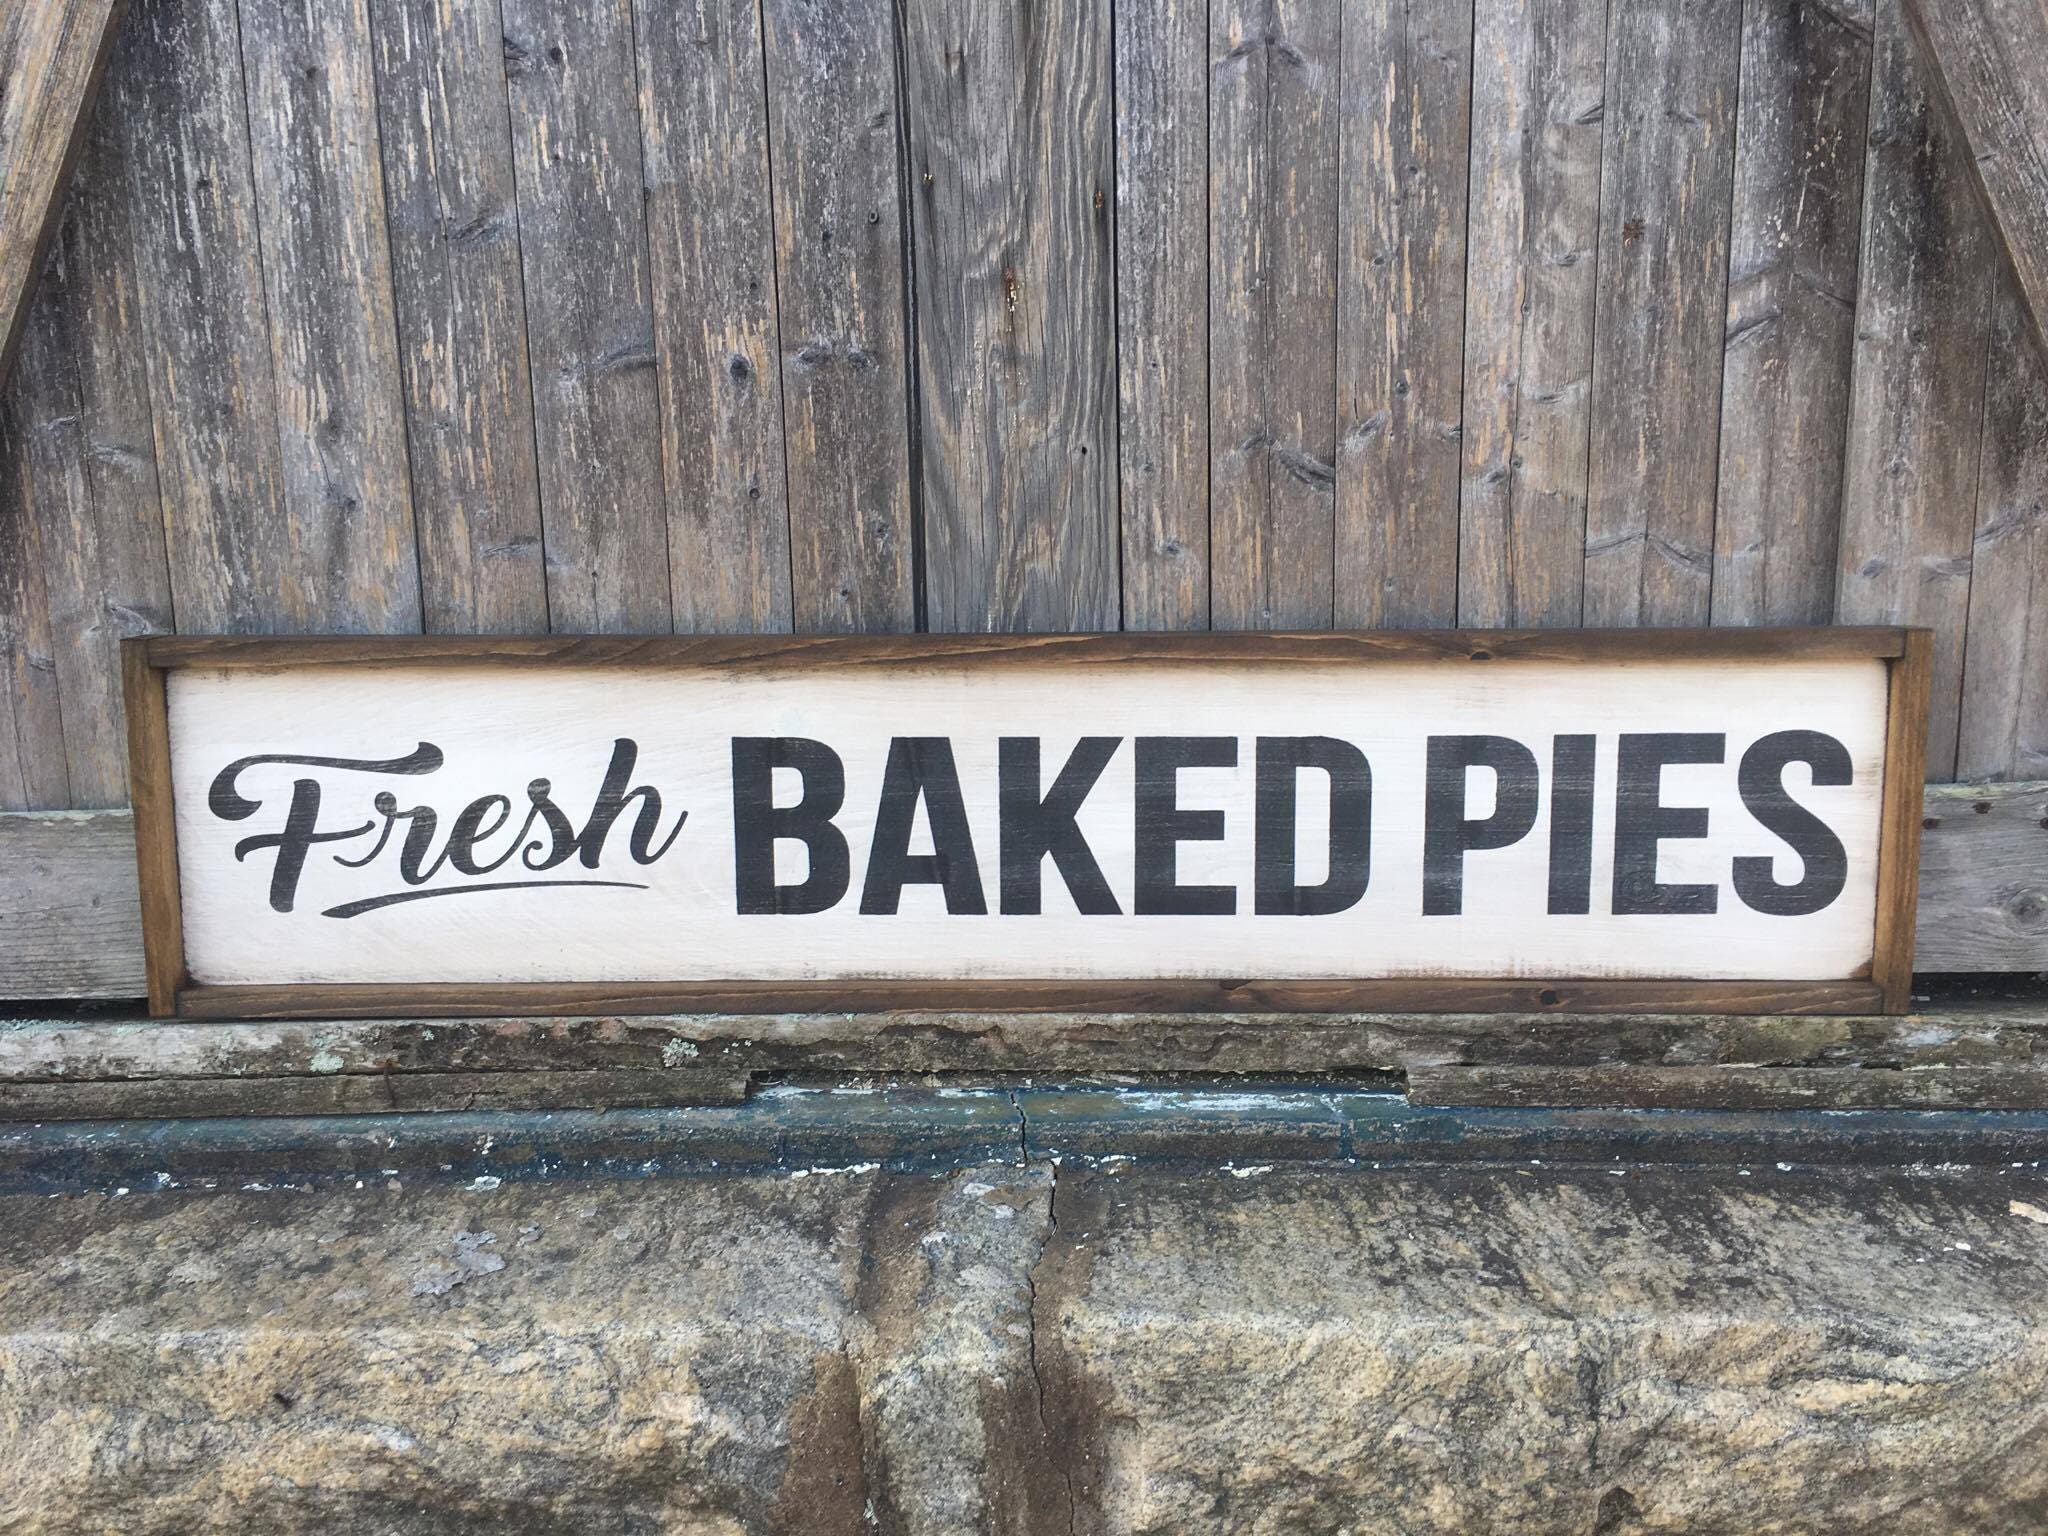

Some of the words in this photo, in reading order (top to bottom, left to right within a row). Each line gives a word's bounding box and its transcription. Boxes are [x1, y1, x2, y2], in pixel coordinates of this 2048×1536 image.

[208, 737, 688, 914] Fresh
[731, 735, 1372, 917] BAKED
[1422, 729, 1853, 917] PIES
